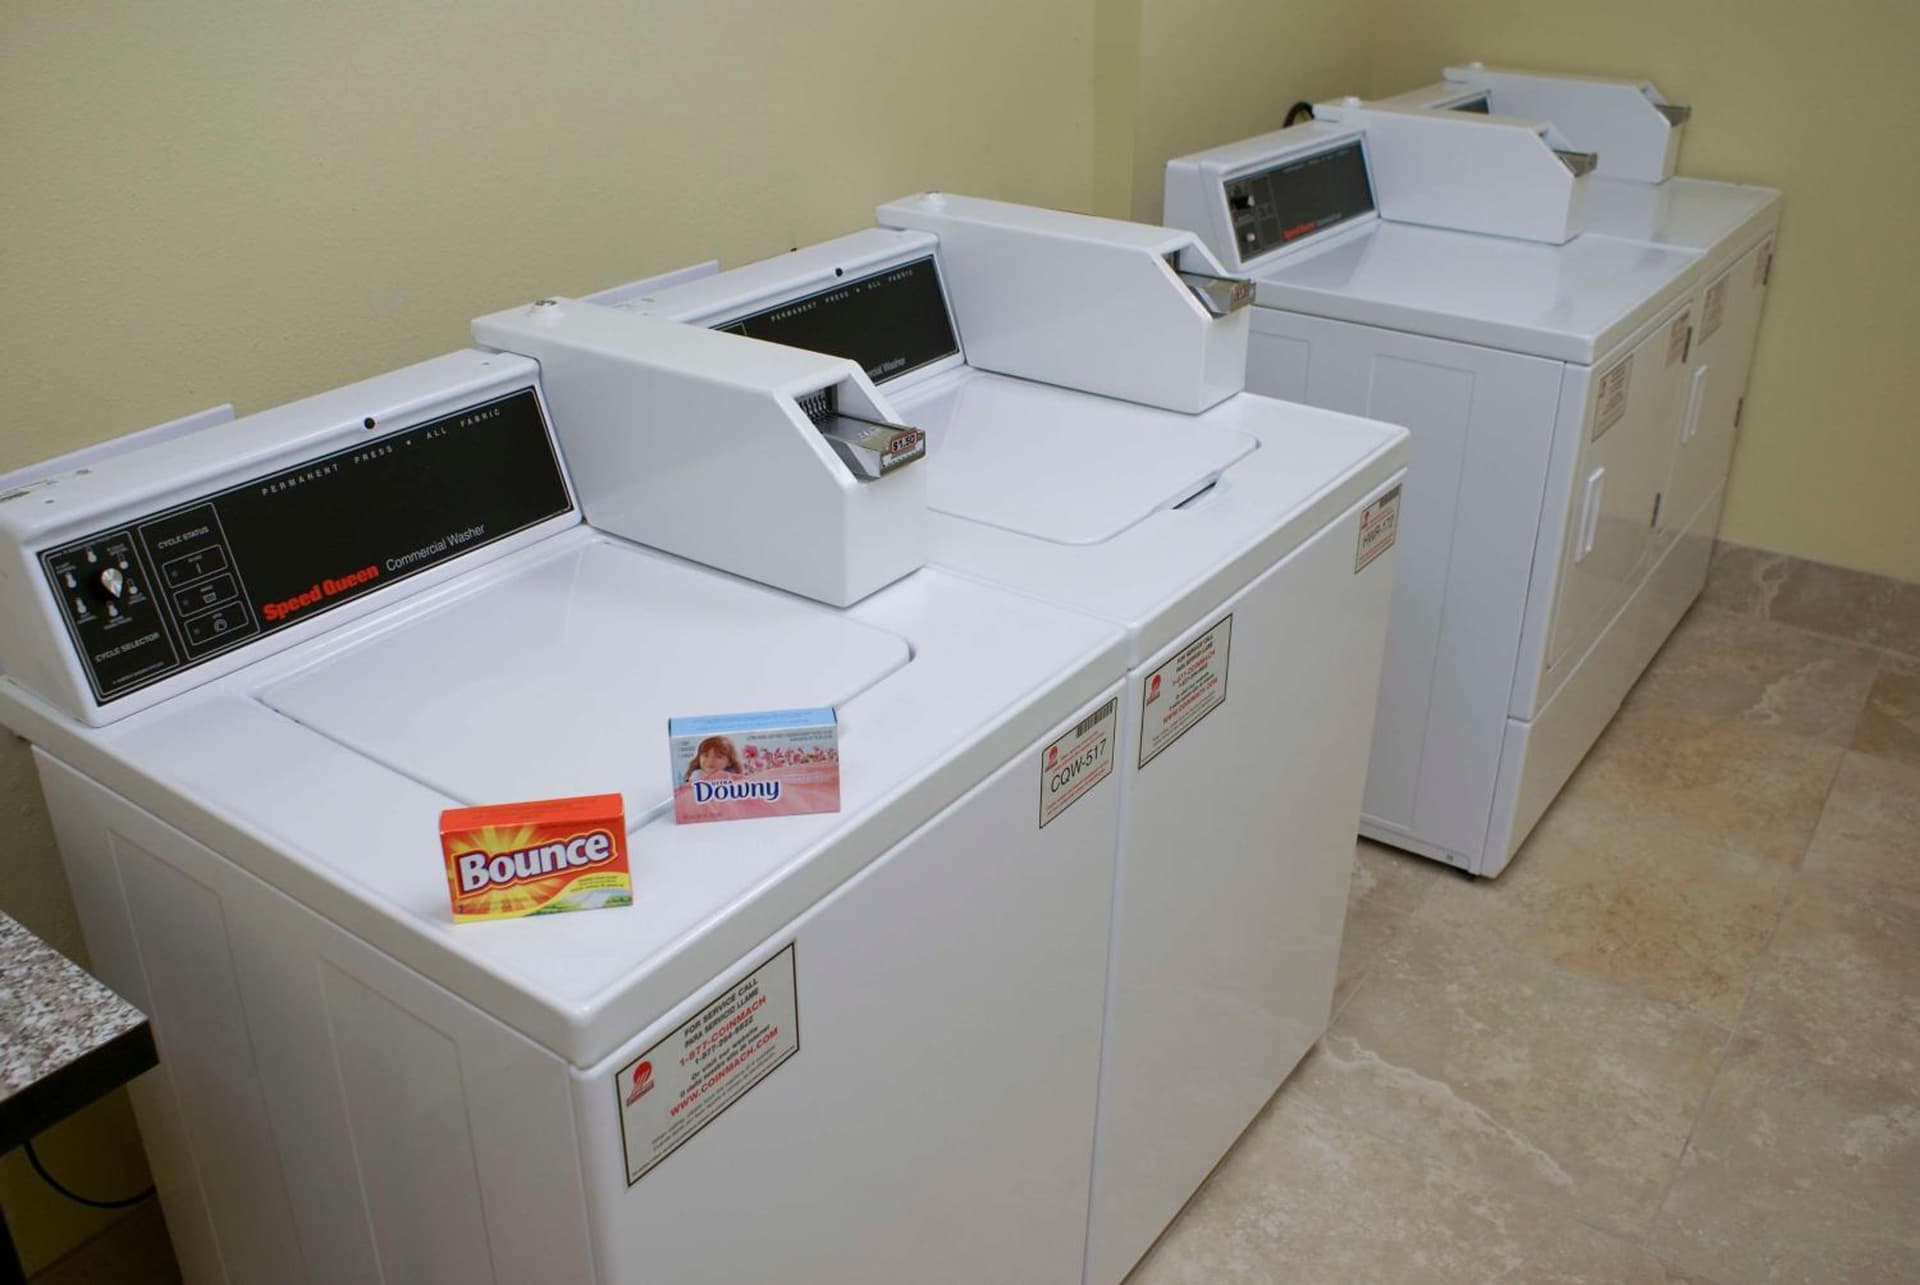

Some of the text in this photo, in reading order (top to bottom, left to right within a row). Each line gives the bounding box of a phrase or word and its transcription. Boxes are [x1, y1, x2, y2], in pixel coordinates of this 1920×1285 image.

[262, 407, 501, 496] PERMANENT PRESS ALL FABRIC
[157, 526, 210, 550] CYCLE STATUS
[262, 523, 485, 621] Speed Queen Commercial Washer
[95, 631, 160, 663] CYCLE SELECTOR
[694, 781, 779, 803] Downy
[1050, 738, 1107, 793] CQW-517
[459, 833, 610, 892] Bounce
[679, 995, 766, 1065] 1-877-COINMACH
[684, 978, 757, 1036] FOR SERVICE CALL
[684, 988, 758, 1047] PARA SERVICIO LLAME
[670, 1027, 778, 1116] WWW.COINMACH.COM
